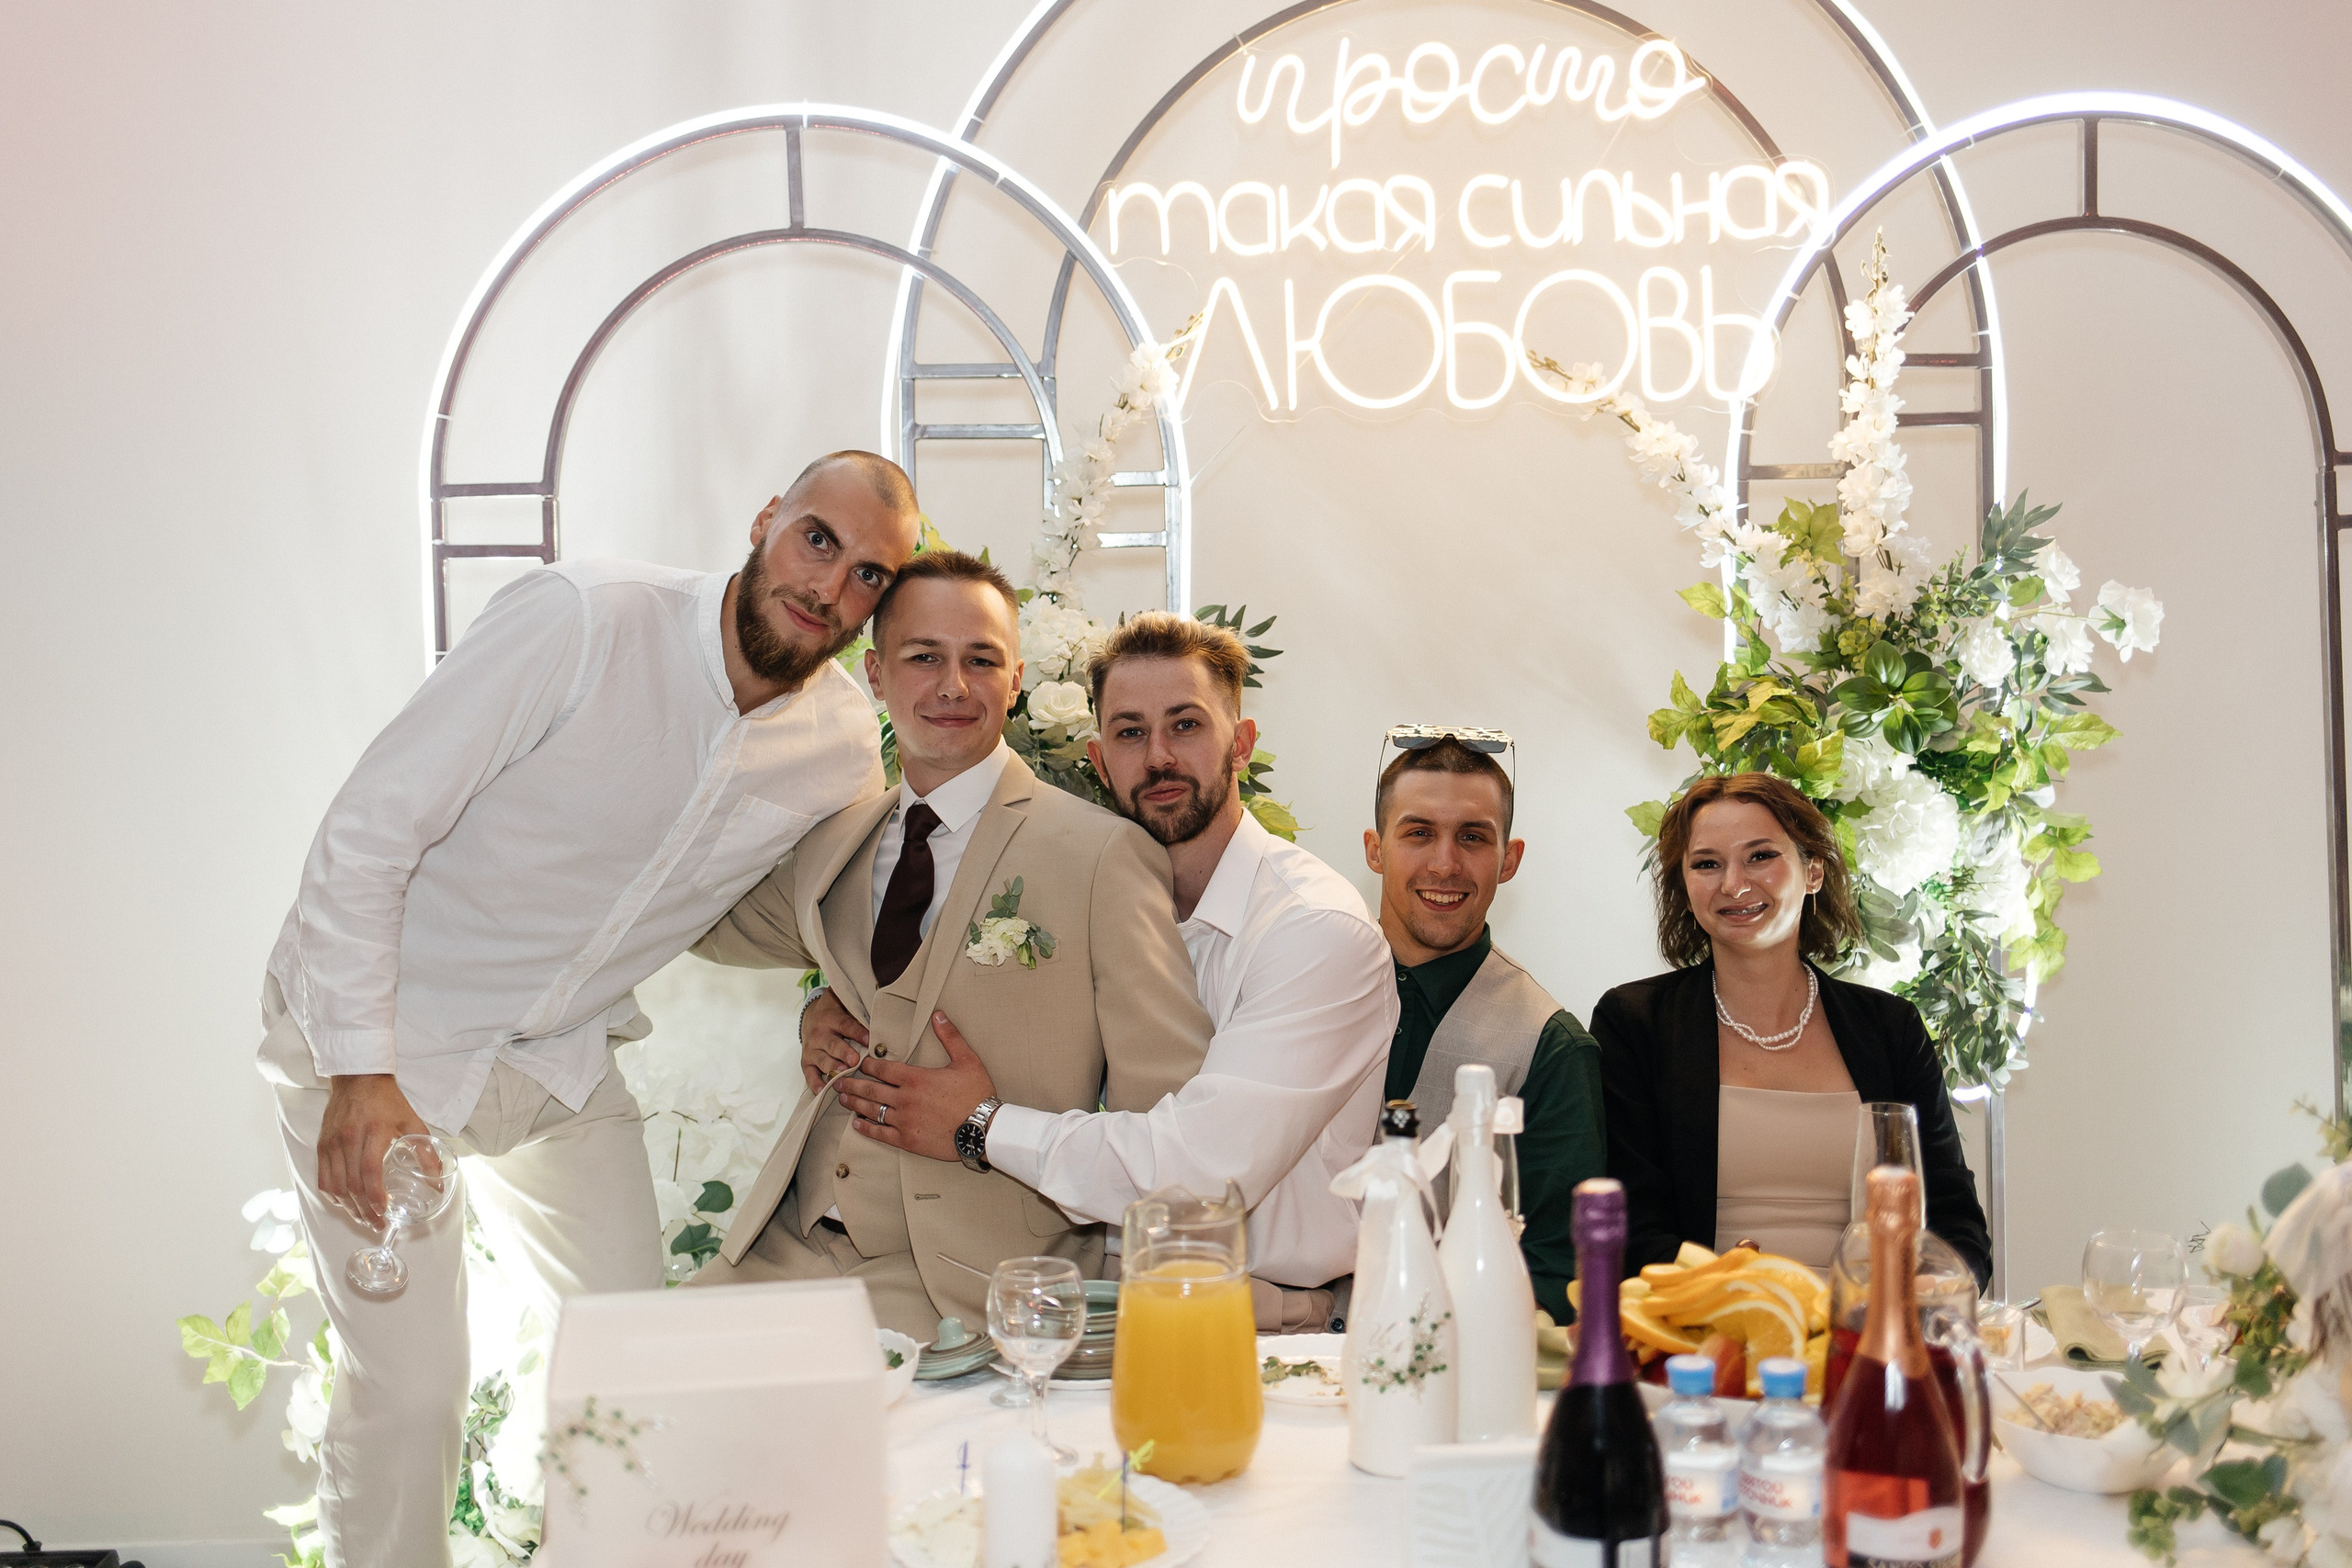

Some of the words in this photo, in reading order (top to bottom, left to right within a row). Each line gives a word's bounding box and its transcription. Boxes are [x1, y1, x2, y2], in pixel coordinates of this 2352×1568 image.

[1236, 36, 1706, 169] просто
[1107, 174, 1436, 254] такая
[1458, 160, 1830, 248] сильная
[1173, 265, 1779, 411] ЛЮБОВЬ
[645, 1493, 790, 1543] Wedding
